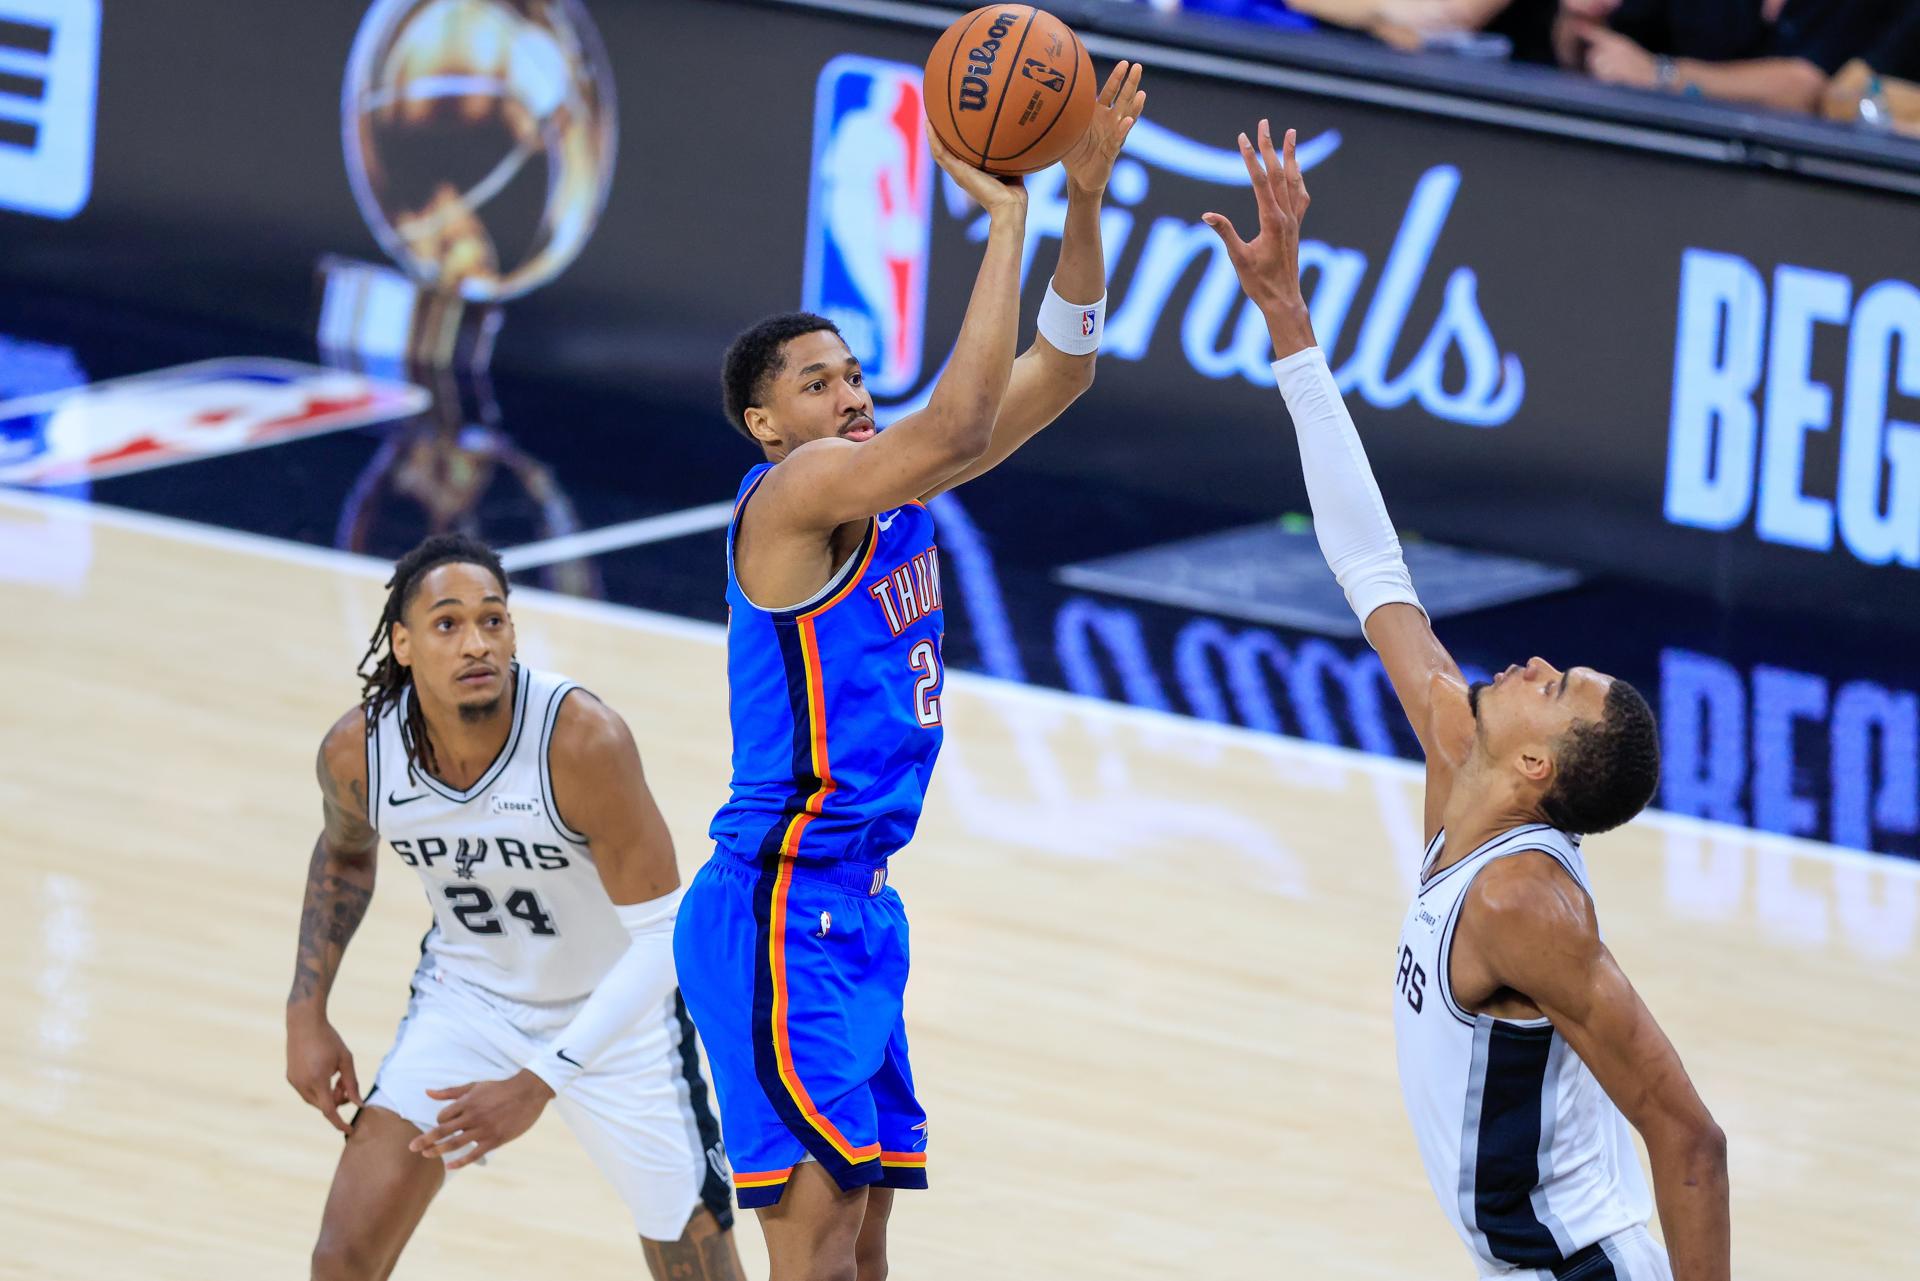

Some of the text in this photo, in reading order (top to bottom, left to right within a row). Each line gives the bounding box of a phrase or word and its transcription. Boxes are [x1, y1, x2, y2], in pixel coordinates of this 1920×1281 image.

[959, 13, 1020, 112] Wilson
[908, 638, 945, 728] 2
[497, 801, 533, 811] LEDGER
[443, 883, 561, 937] 24
[1396, 944, 1426, 1015] RS
